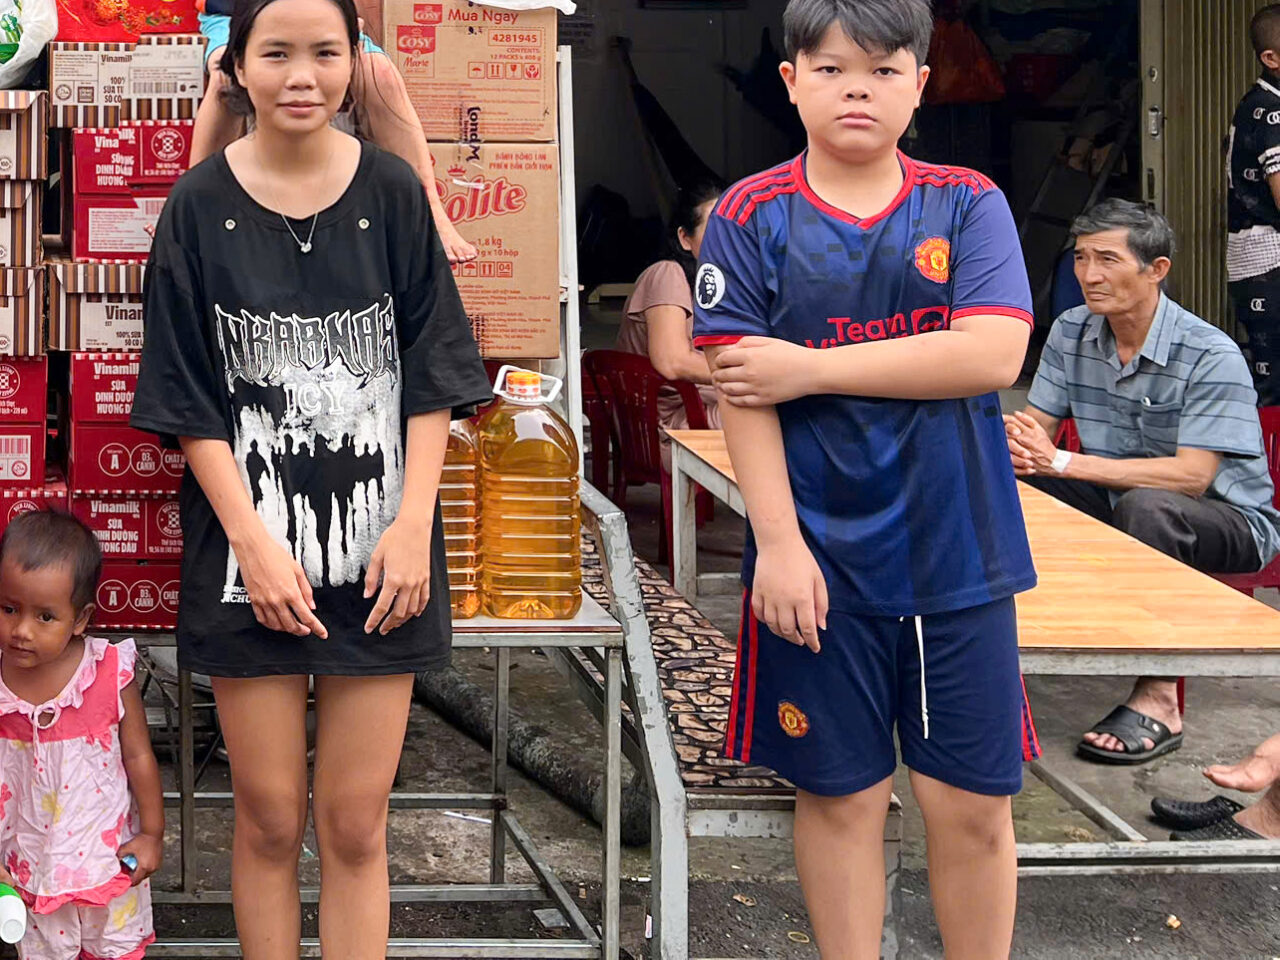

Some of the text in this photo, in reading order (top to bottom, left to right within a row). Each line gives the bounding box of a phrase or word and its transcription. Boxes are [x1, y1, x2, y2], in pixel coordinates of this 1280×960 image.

[447, 9, 479, 22] Mua
[482, 10, 520, 25] Ngay
[492, 33, 538, 43] 4281945
[491, 236, 503, 248] kg
[498, 263, 511, 272] 04
[90, 500, 140, 514] Vinamilk
